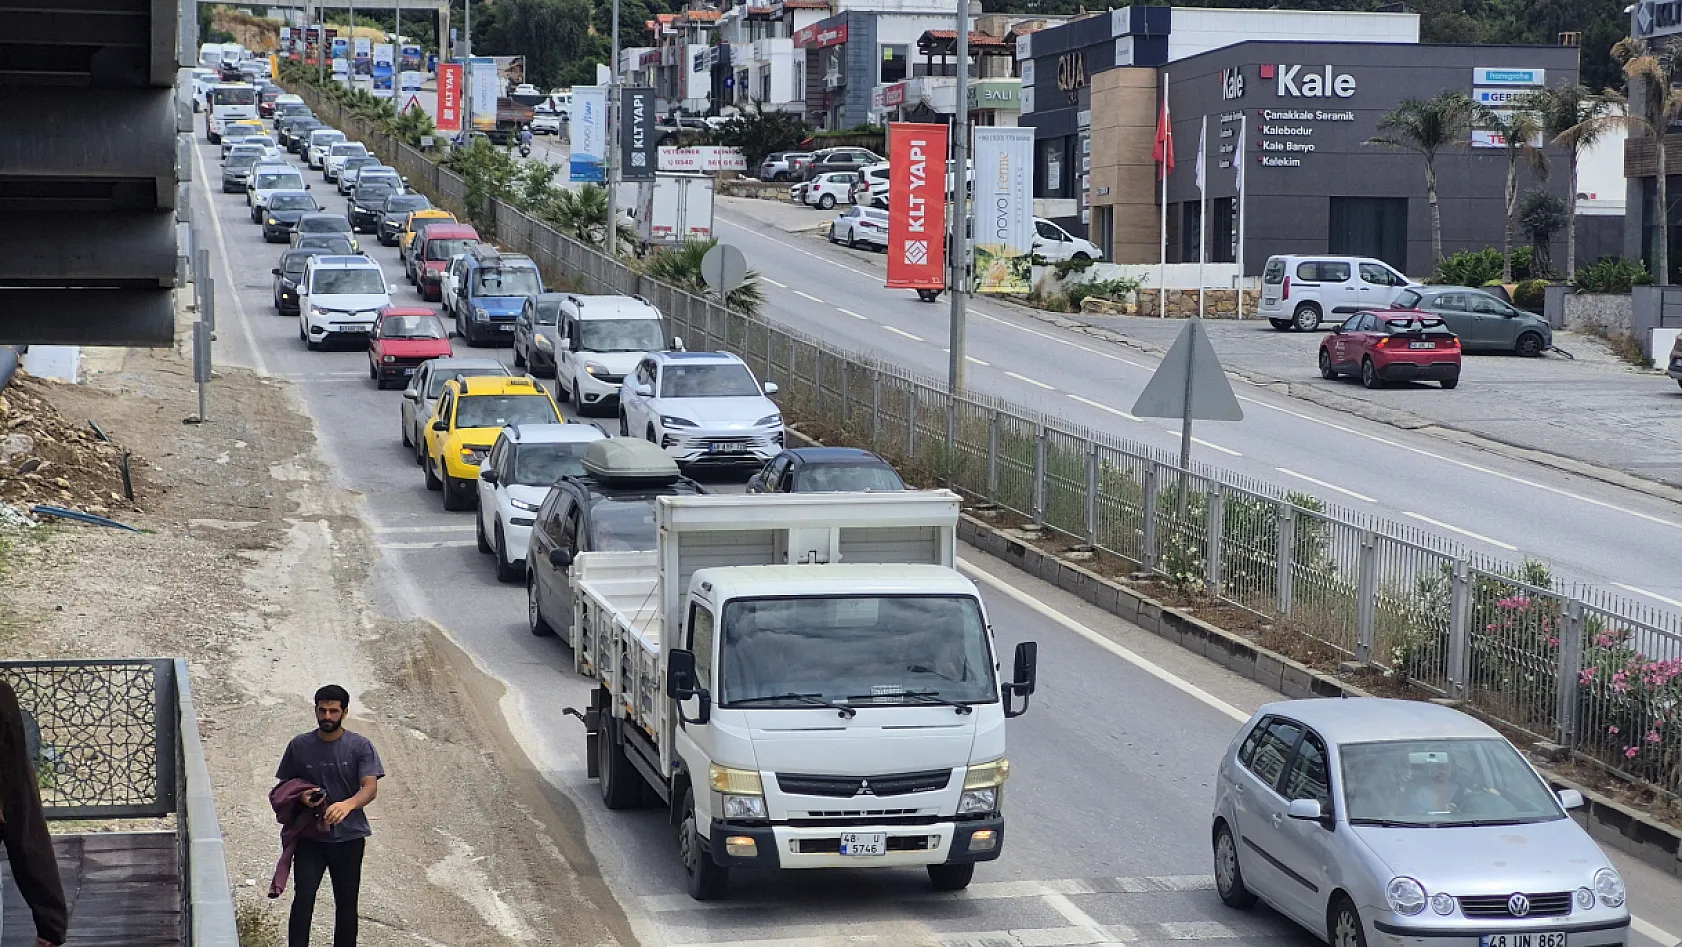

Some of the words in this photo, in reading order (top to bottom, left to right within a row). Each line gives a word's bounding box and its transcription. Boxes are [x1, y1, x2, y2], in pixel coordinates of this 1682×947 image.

[1058, 50, 1085, 91] QUA
[1277, 64, 1356, 98] Kale
[1222, 66, 1244, 100] Kale
[633, 94, 644, 126] YAPI
[1264, 110, 1313, 121] Çanakkale
[1315, 110, 1354, 121] Seramik
[583, 128, 592, 152] novo
[633, 127, 644, 148] KLT
[1263, 125, 1313, 135] Kalebodur
[1263, 141, 1284, 151] Kale
[1286, 141, 1316, 153] Banyo
[909, 140, 927, 190] YAPI
[1262, 156, 1301, 167] Kalekim
[908, 194, 925, 233] KLT
[996, 198, 1008, 240] novo
[843, 834, 856, 843] 48
[873, 834, 879, 843] U
[852, 844, 878, 854] 5746
[1489, 935, 1506, 947] 48
[1514, 935, 1531, 947] UN
[1539, 933, 1564, 947] 862
